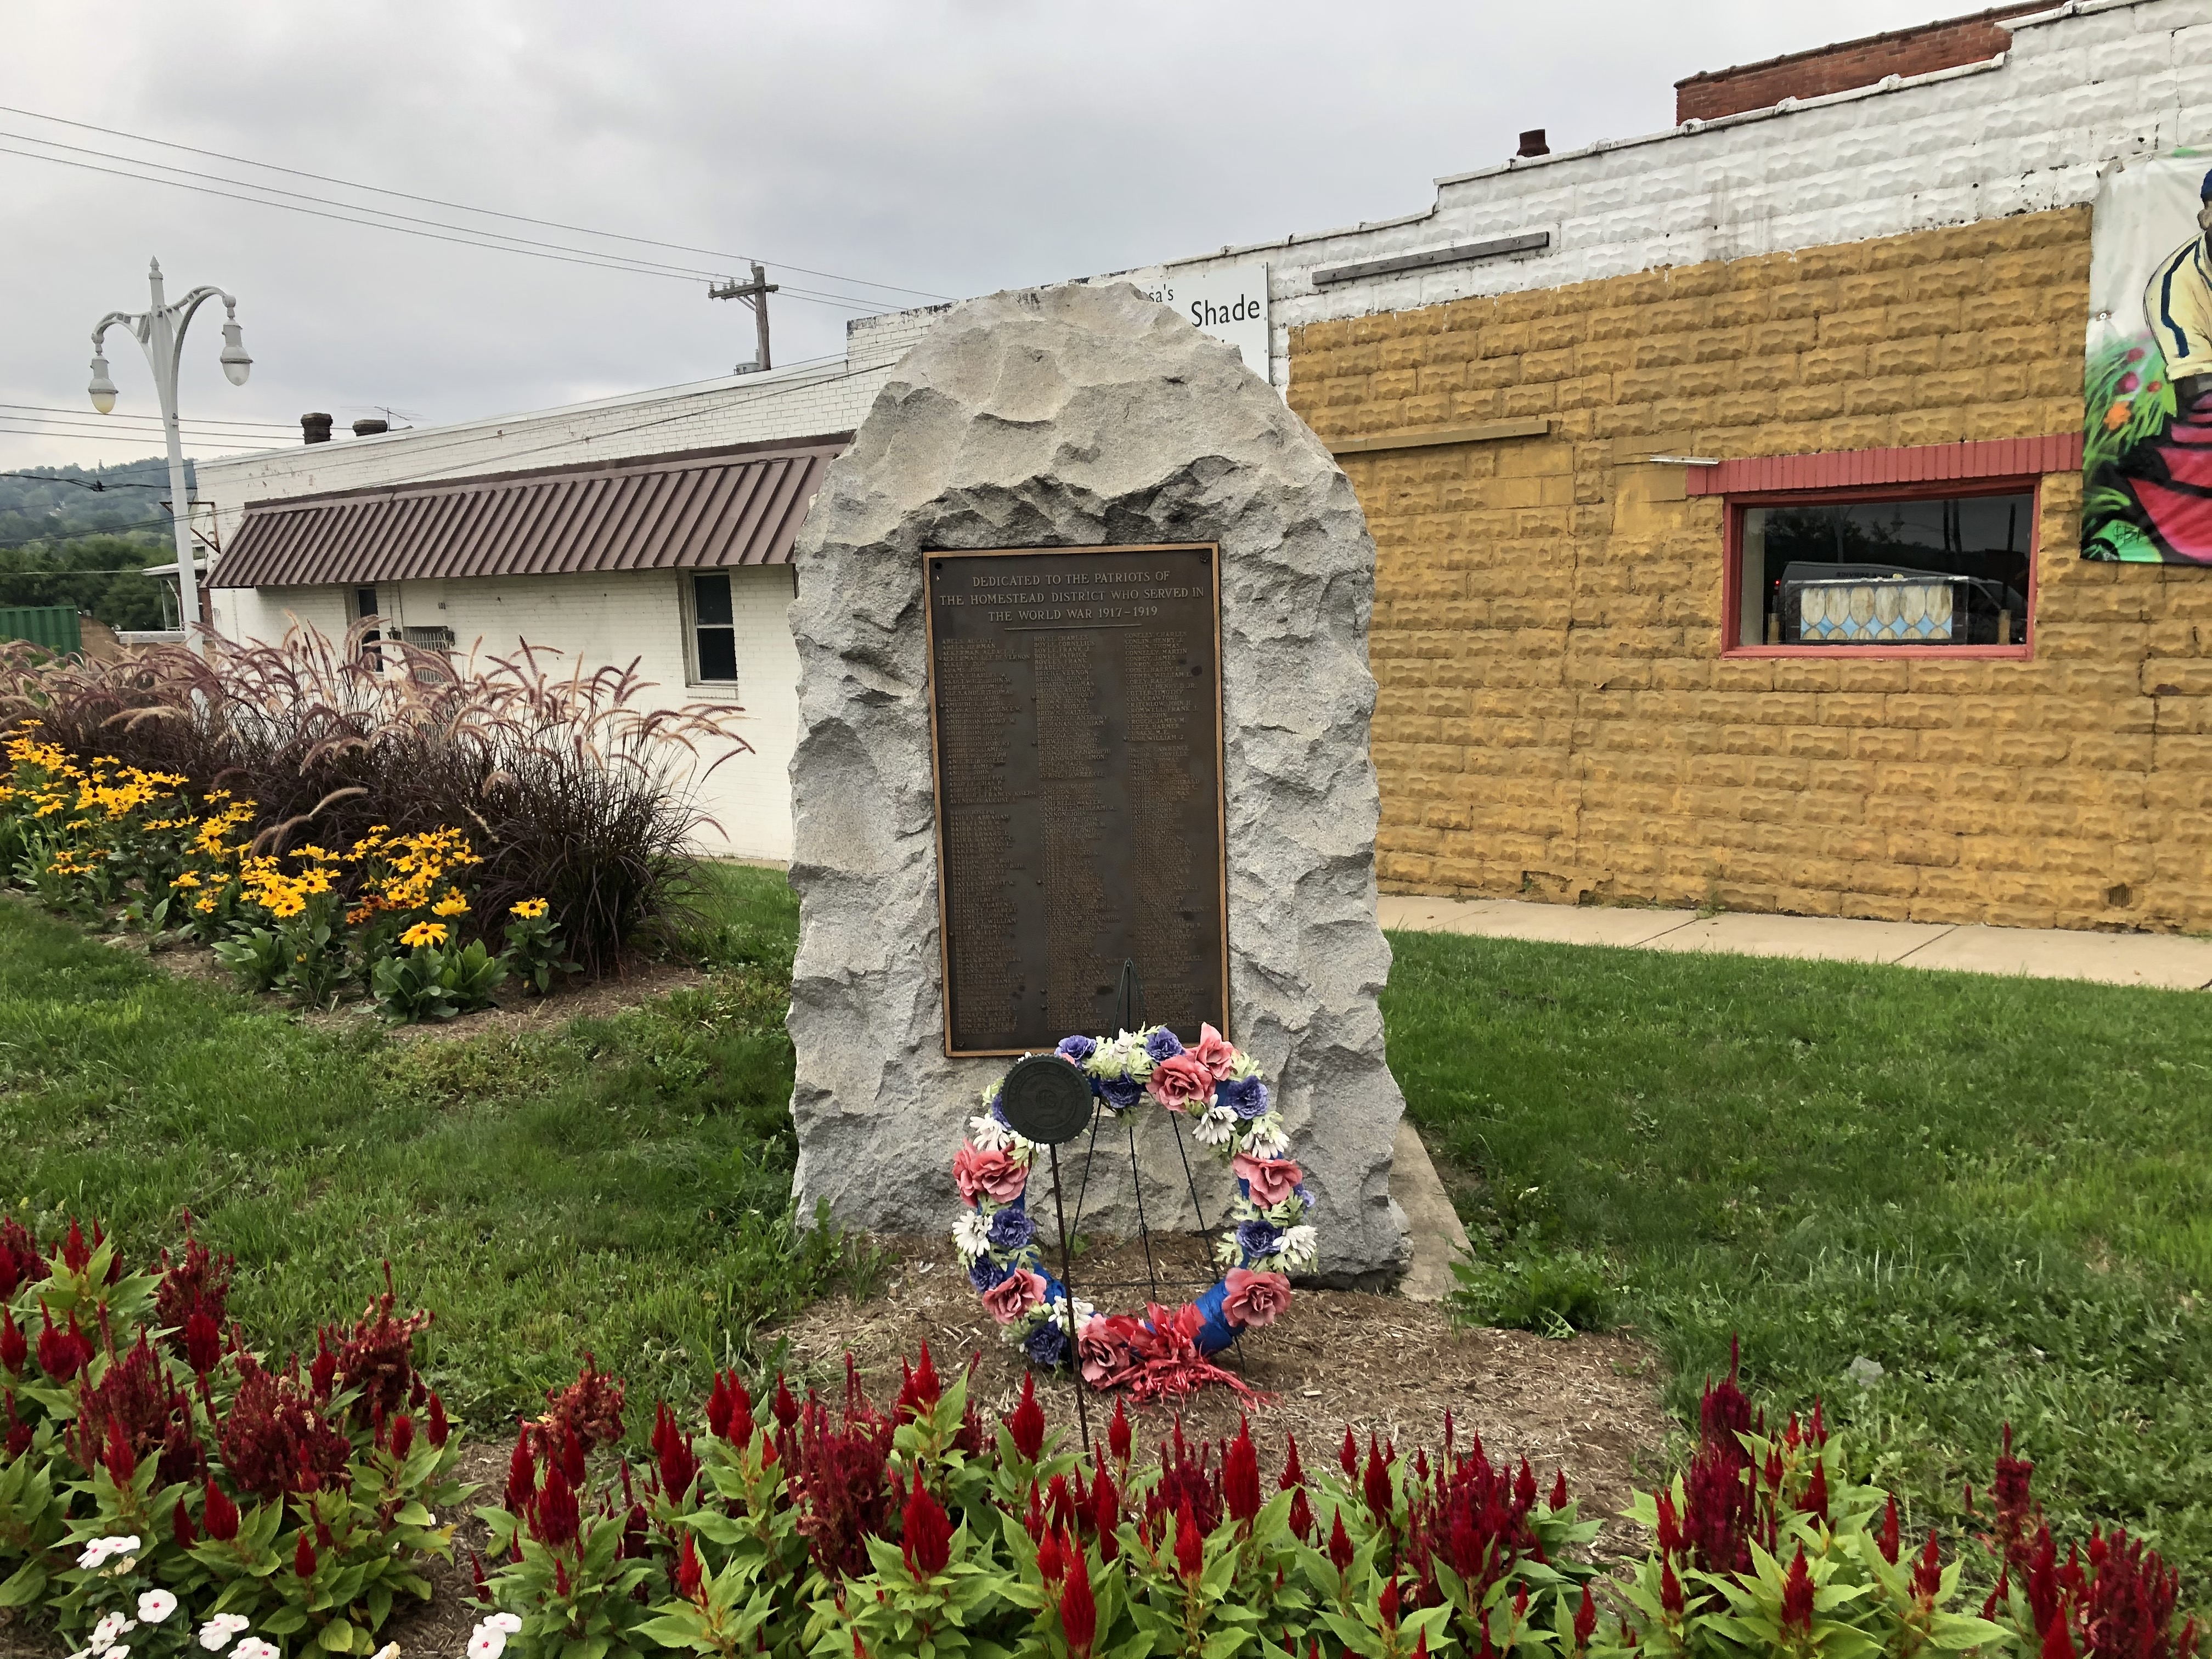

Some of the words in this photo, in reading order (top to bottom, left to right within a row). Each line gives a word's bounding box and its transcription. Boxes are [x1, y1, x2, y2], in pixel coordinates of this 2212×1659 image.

[1149, 284, 1174, 303] sa's
[1191, 294, 1260, 328] Shade
[973, 574, 1040, 588] DEDICATED
[1045, 574, 1060, 585] TO
[1066, 573, 1088, 585] THE
[1095, 572, 1150, 583] PATRIOTS
[1155, 571, 1170, 582] OF
[940, 595, 964, 606] THE
[970, 592, 1044, 605] HOMESTEAD
[1051, 590, 1105, 603] DISTRICT
[1111, 590, 1138, 601] WHO
[1144, 588, 1188, 599] SERVED
[1192, 587, 1204, 598] IN
[989, 611, 1013, 622] THE
[1019, 609, 1061, 620] WORLD
[1068, 608, 1093, 619] WAR
